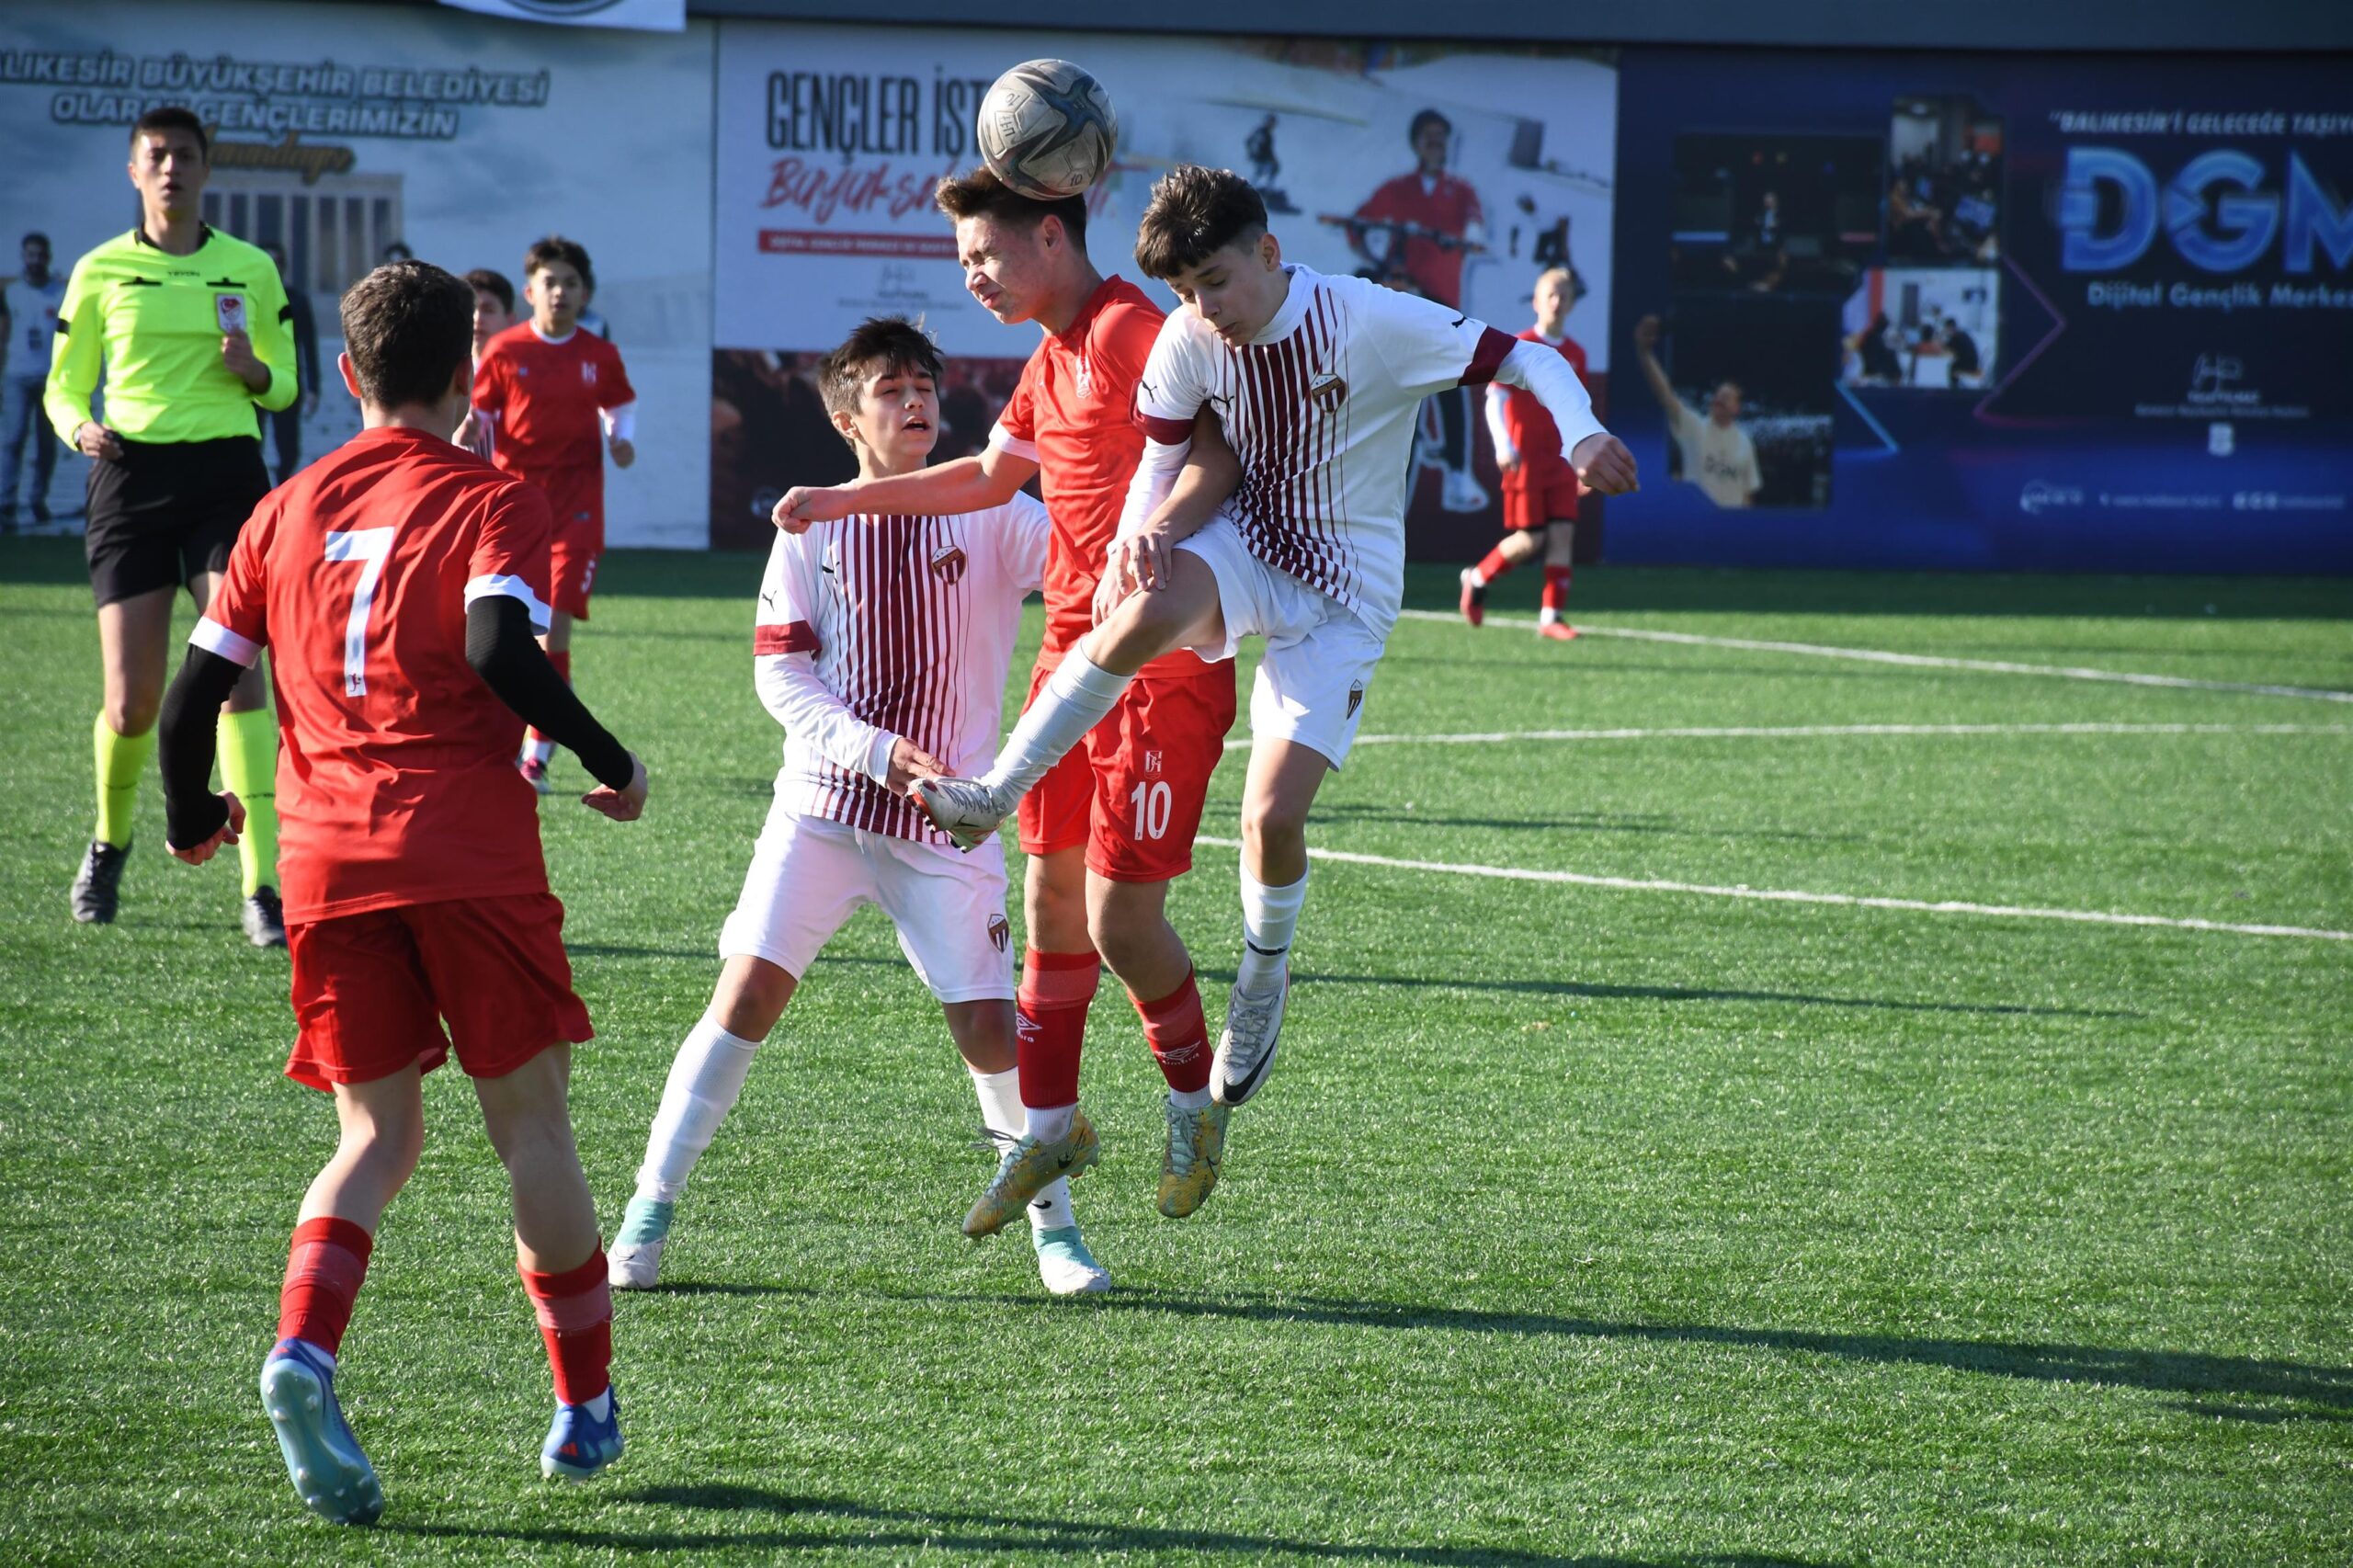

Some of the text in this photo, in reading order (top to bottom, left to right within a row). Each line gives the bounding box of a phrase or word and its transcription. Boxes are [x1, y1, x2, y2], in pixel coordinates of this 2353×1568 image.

[0, 48, 549, 104] LIKESİR BÜYÜKŞEHİR BELEDİYESİ
[198, 98, 456, 139] GENÇLERİMİZİN
[766, 64, 992, 165] GENÇLER İST
[2059, 146, 2353, 273] DGM
[2087, 278, 2161, 312] Dijital
[2169, 278, 2262, 312] Gençlik
[324, 526, 395, 698] 7
[1131, 781, 1172, 841] 10
